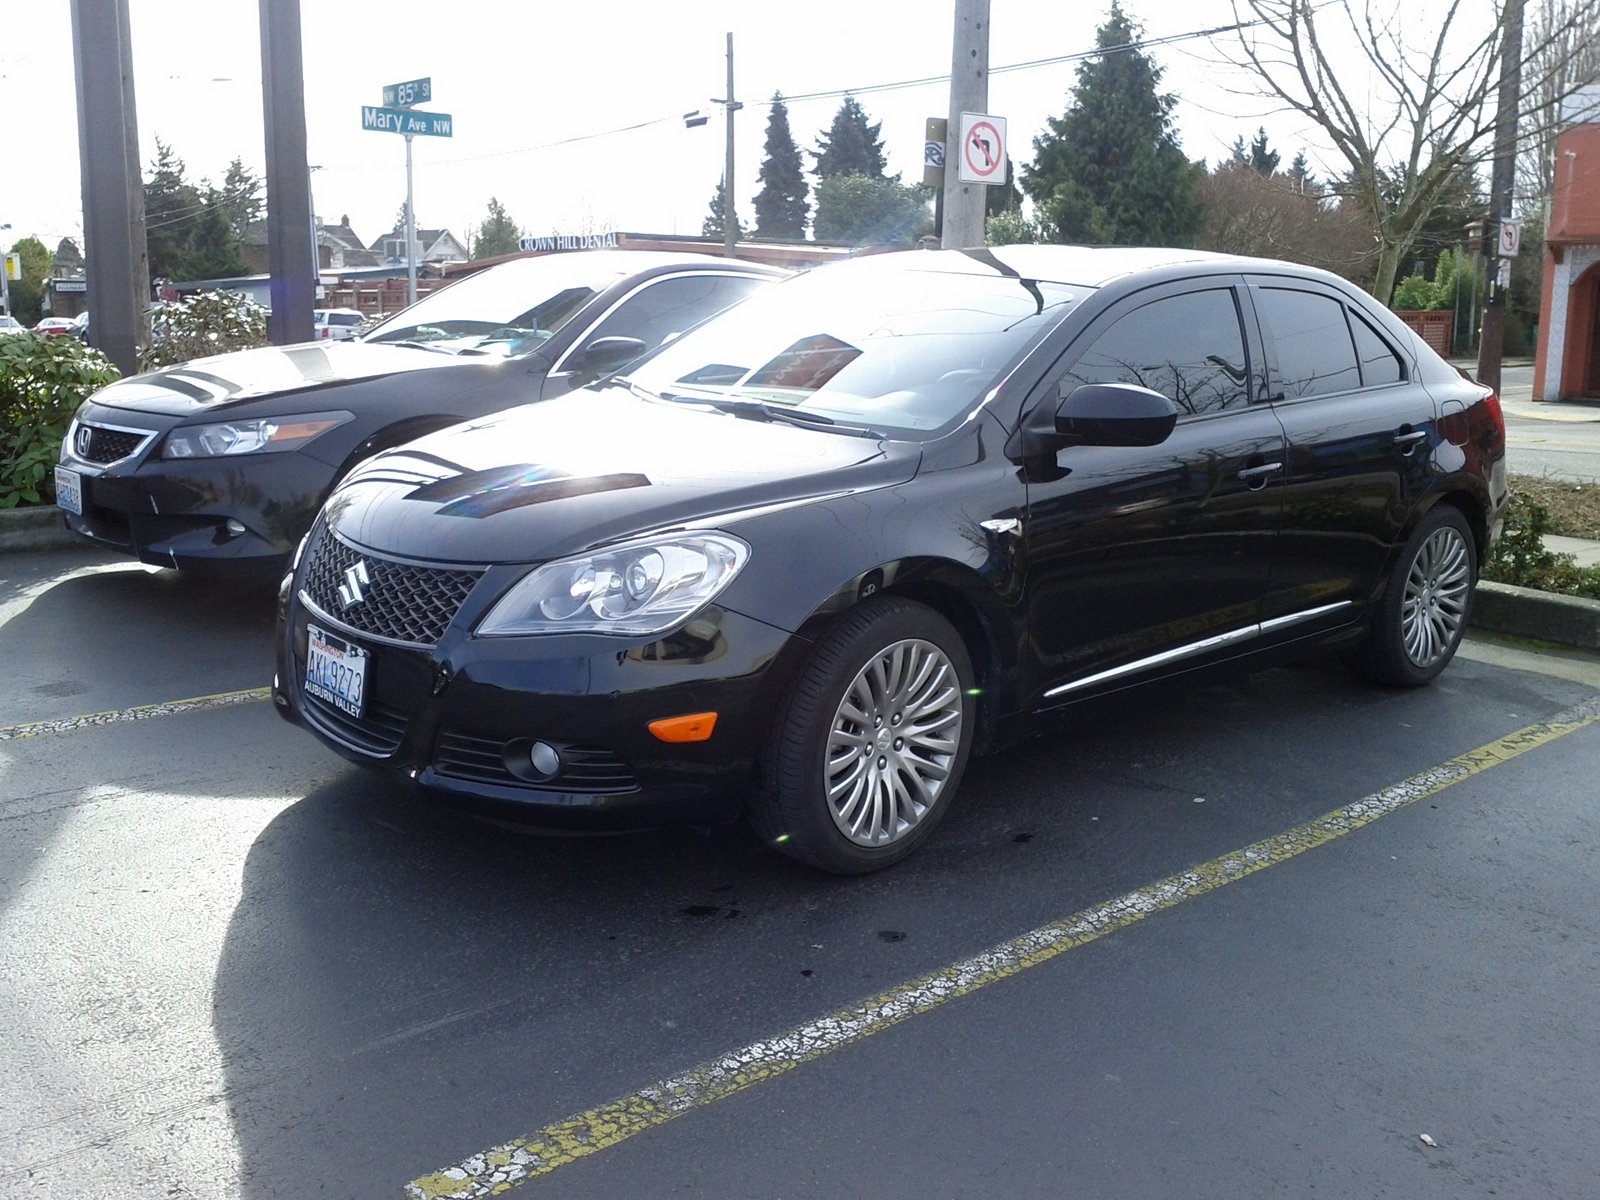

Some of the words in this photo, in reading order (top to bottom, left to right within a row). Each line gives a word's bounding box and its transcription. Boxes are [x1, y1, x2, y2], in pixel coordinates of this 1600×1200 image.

[383, 90, 395, 103] NW
[364, 107, 404, 132] Mary
[407, 117, 427, 131] Ave
[433, 120, 451, 134] NW
[518, 237, 555, 252] CROWN
[557, 235, 578, 249] HILL
[580, 232, 619, 249] DENTAL
[311, 638, 345, 660] WASHINGTON
[308, 650, 362, 702] AKL9273
[304, 680, 334, 704] AUBURN
[334, 694, 361, 718] VALLEY
